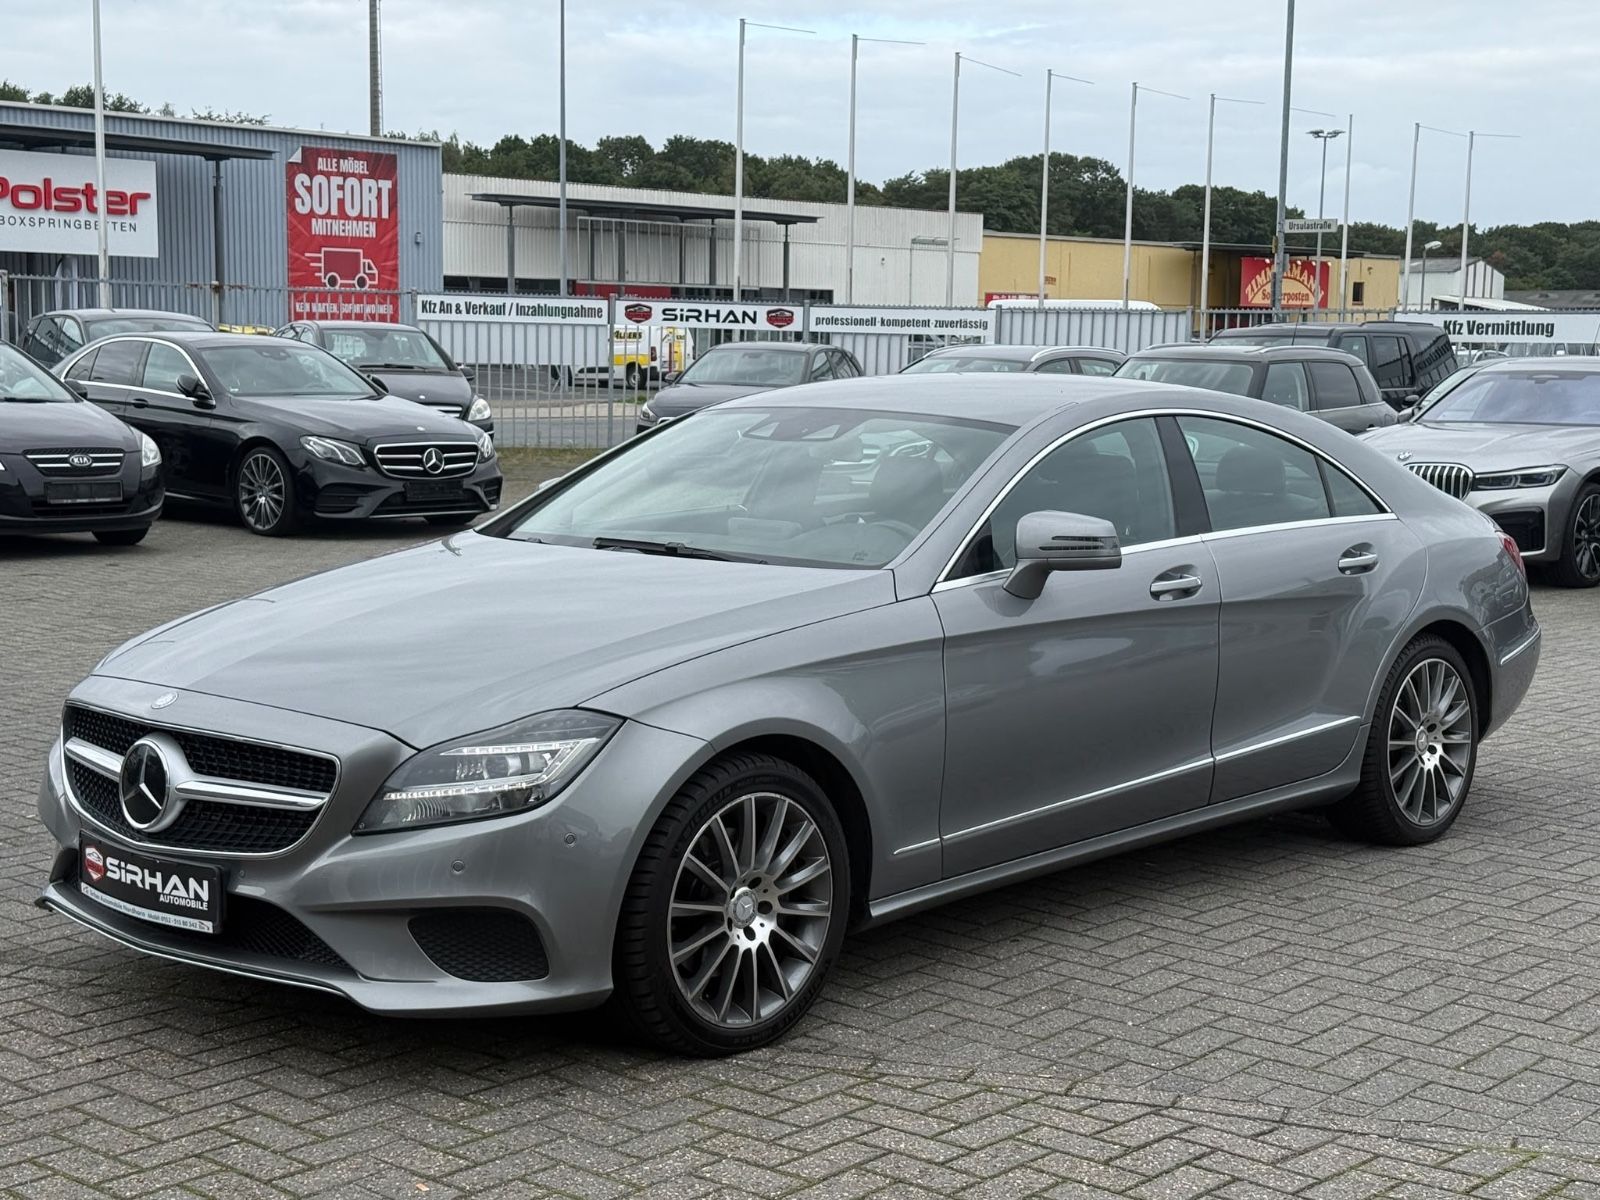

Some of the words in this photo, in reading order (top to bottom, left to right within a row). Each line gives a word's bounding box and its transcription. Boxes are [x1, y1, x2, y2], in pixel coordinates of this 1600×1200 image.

[317, 157, 338, 172] ALLE
[340, 157, 369, 174] MÖBEL
[294, 173, 392, 219] SOFORT
[0, 215, 137, 232] BOXSPRINGBETEN
[311, 217, 376, 238] MITNEHMEN
[1288, 220, 1332, 230] Ursulastraße
[1245, 263, 1324, 302] ZIMMRMAN
[1261, 288, 1310, 302] Sorposten
[295, 302, 310, 313] KEN
[421, 300, 437, 314] Kfz
[439, 301, 452, 315] An
[454, 302, 462, 315] &
[464, 301, 506, 316] Verkauf
[508, 302, 514, 316] /
[515, 302, 603, 319] Inzahlungnahme
[815, 316, 877, 327] professionell
[880, 317, 931, 328] kompetent
[934, 318, 988, 331] zuverlässig
[1443, 320, 1464, 335] Kfz
[1466, 320, 1555, 337] Vermittlung
[159, 894, 209, 911] AUTOMOBILE
